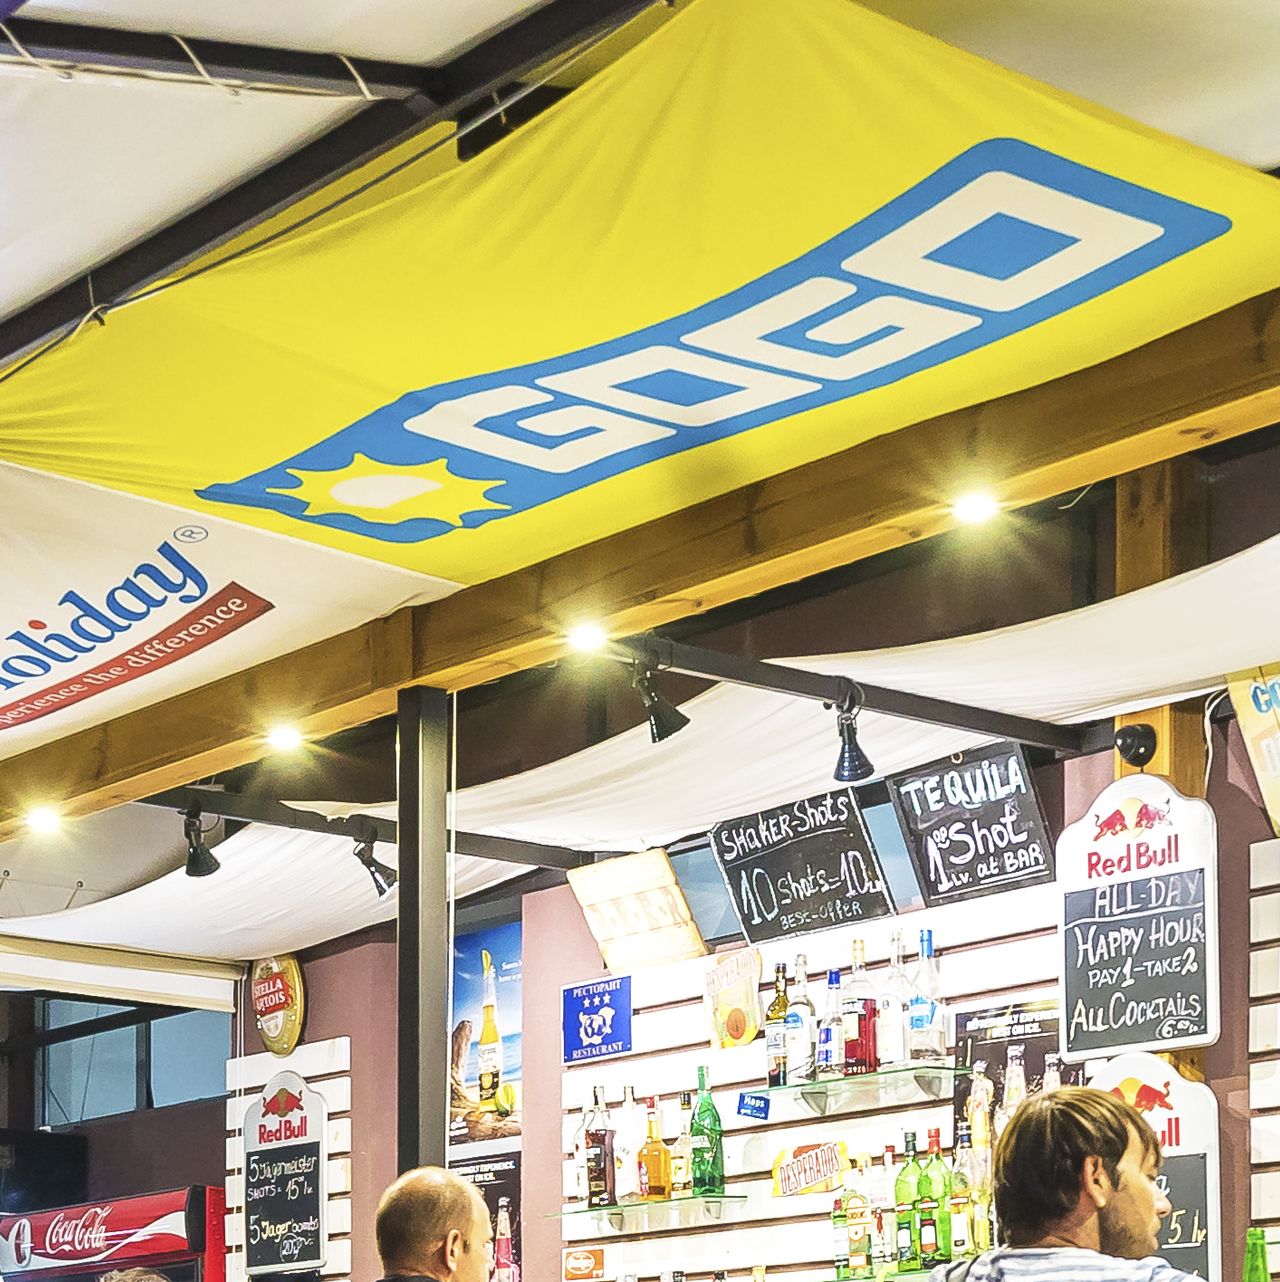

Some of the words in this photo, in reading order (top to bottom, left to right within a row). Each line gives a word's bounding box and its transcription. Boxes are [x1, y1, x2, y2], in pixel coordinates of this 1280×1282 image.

[404, 170, 1166, 475] GOGO
[85, 662, 129, 690] the
[124, 596, 250, 671] difference
[948, 802, 1029, 865] Shot
[976, 852, 1000, 878] at
[1003, 842, 1046, 873] BAR
[1087, 842, 1132, 879] Red
[1136, 834, 1179, 870] Bull
[740, 868, 780, 926] 10
[1094, 869, 1203, 919] ALL-DAY
[1075, 923, 1144, 969] HAPPY
[1148, 912, 1206, 950] HOUR
[255, 978, 283, 998] STELLA
[256, 991, 286, 1010] ARTOIS
[572, 1041, 624, 1060] RESTAURANT
[258, 1119, 282, 1144] Red
[283, 1115, 308, 1141] Bull
[1154, 1116, 1181, 1148] ull
[248, 1155, 260, 1182] 5
[779, 1143, 840, 1195] DESPERADOS
[249, 1214, 261, 1244] 5
